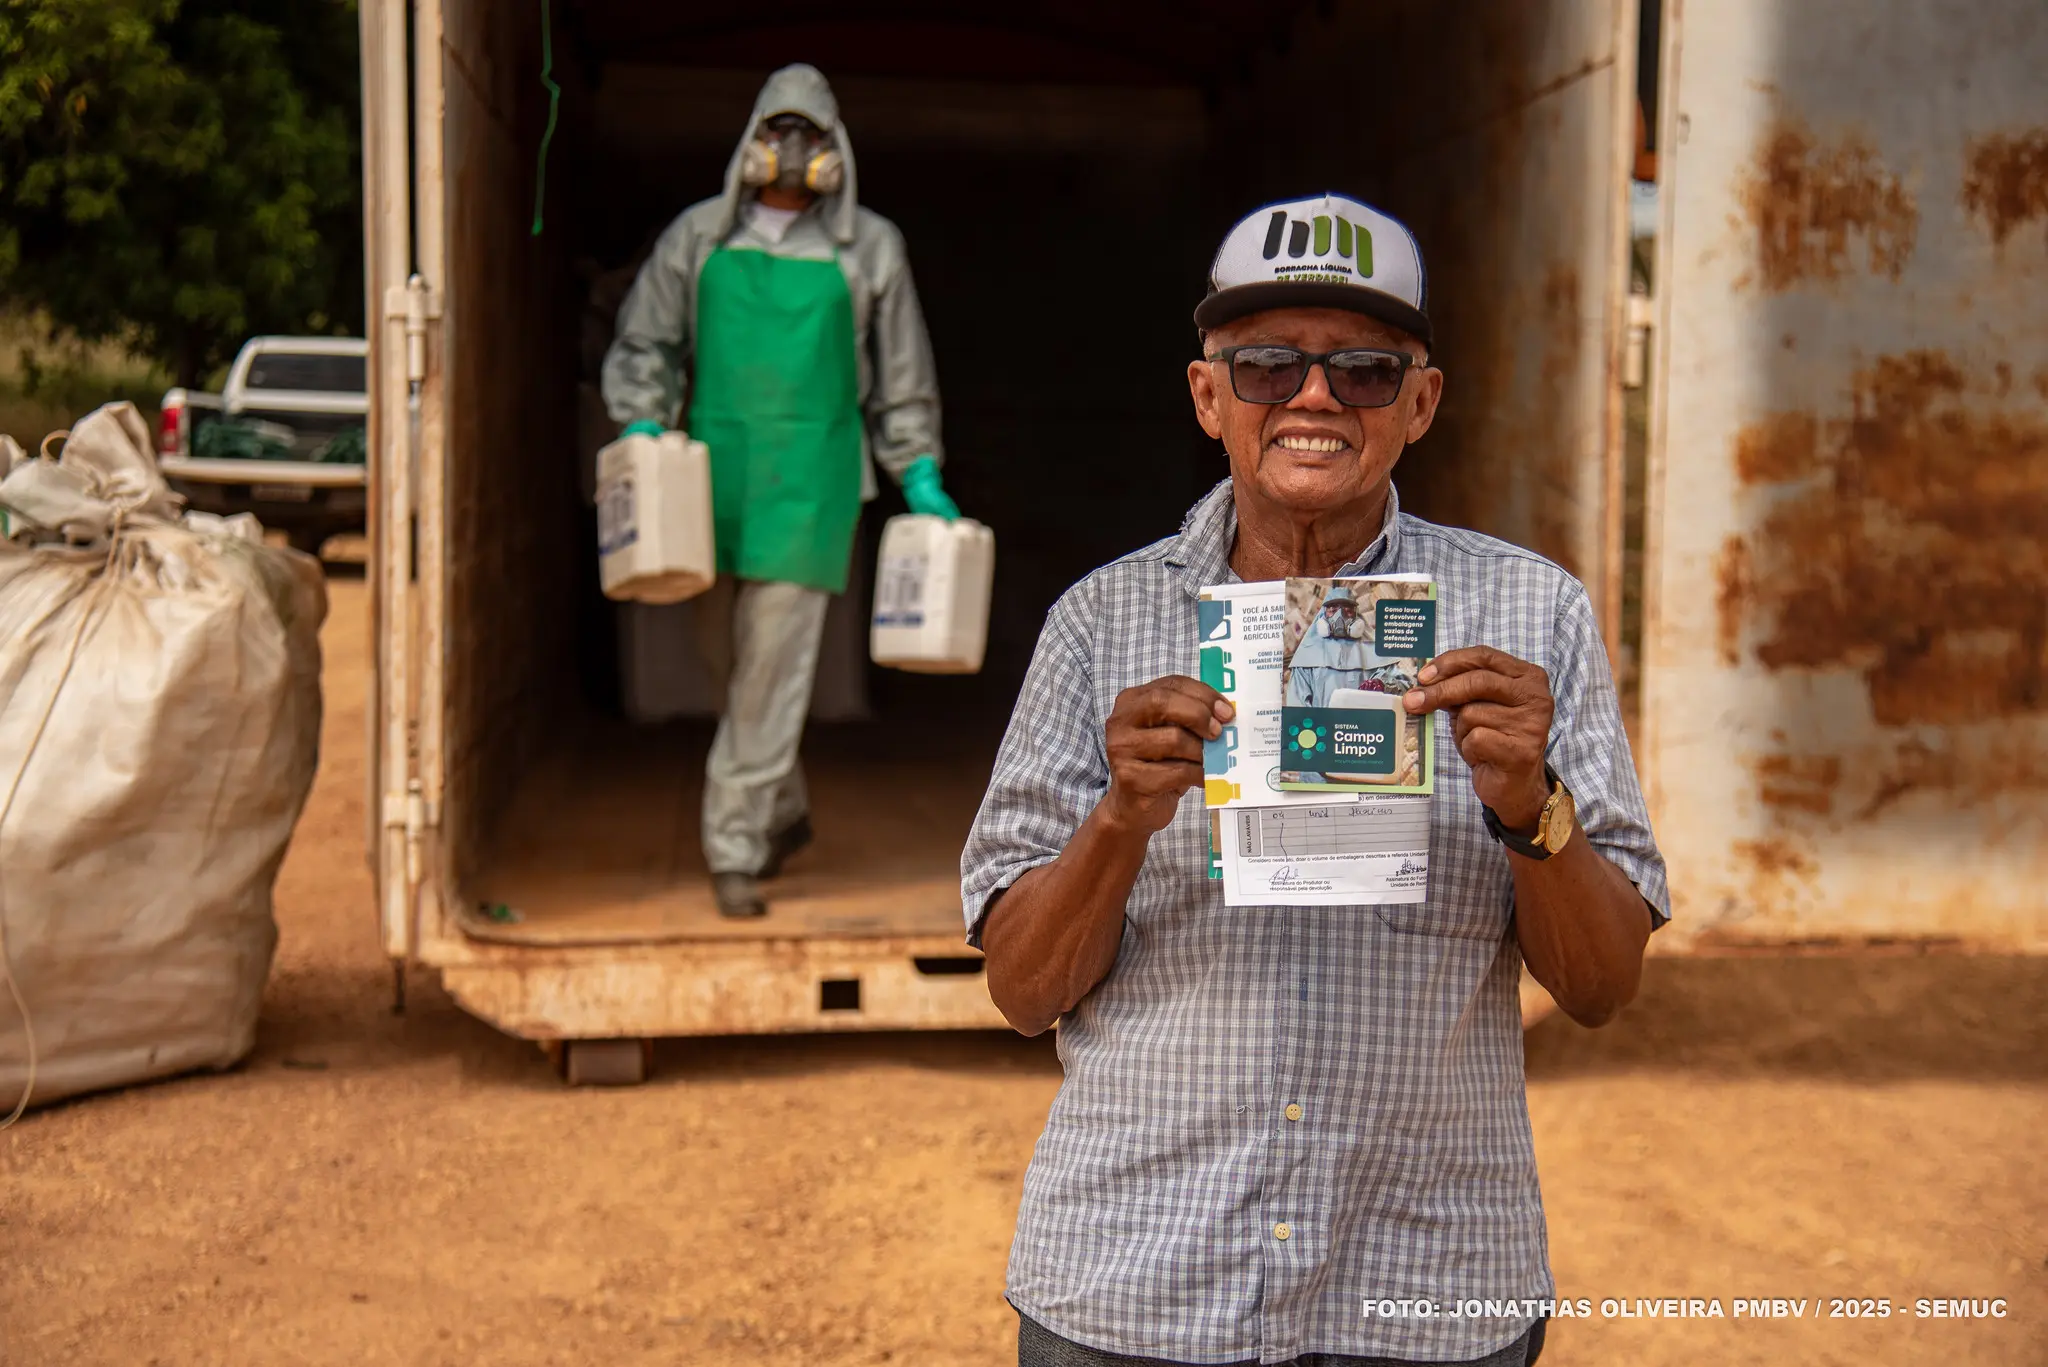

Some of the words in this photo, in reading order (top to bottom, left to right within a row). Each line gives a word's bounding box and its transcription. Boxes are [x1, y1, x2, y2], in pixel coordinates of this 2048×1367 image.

[1275, 265, 1318, 273] BORRACHA
[1320, 263, 1352, 275] LÍQUIDA
[1243, 632, 1280, 641] AGRÍCOLAS
[1334, 730, 1385, 745] Campo
[1334, 742, 1377, 757] Limpo
